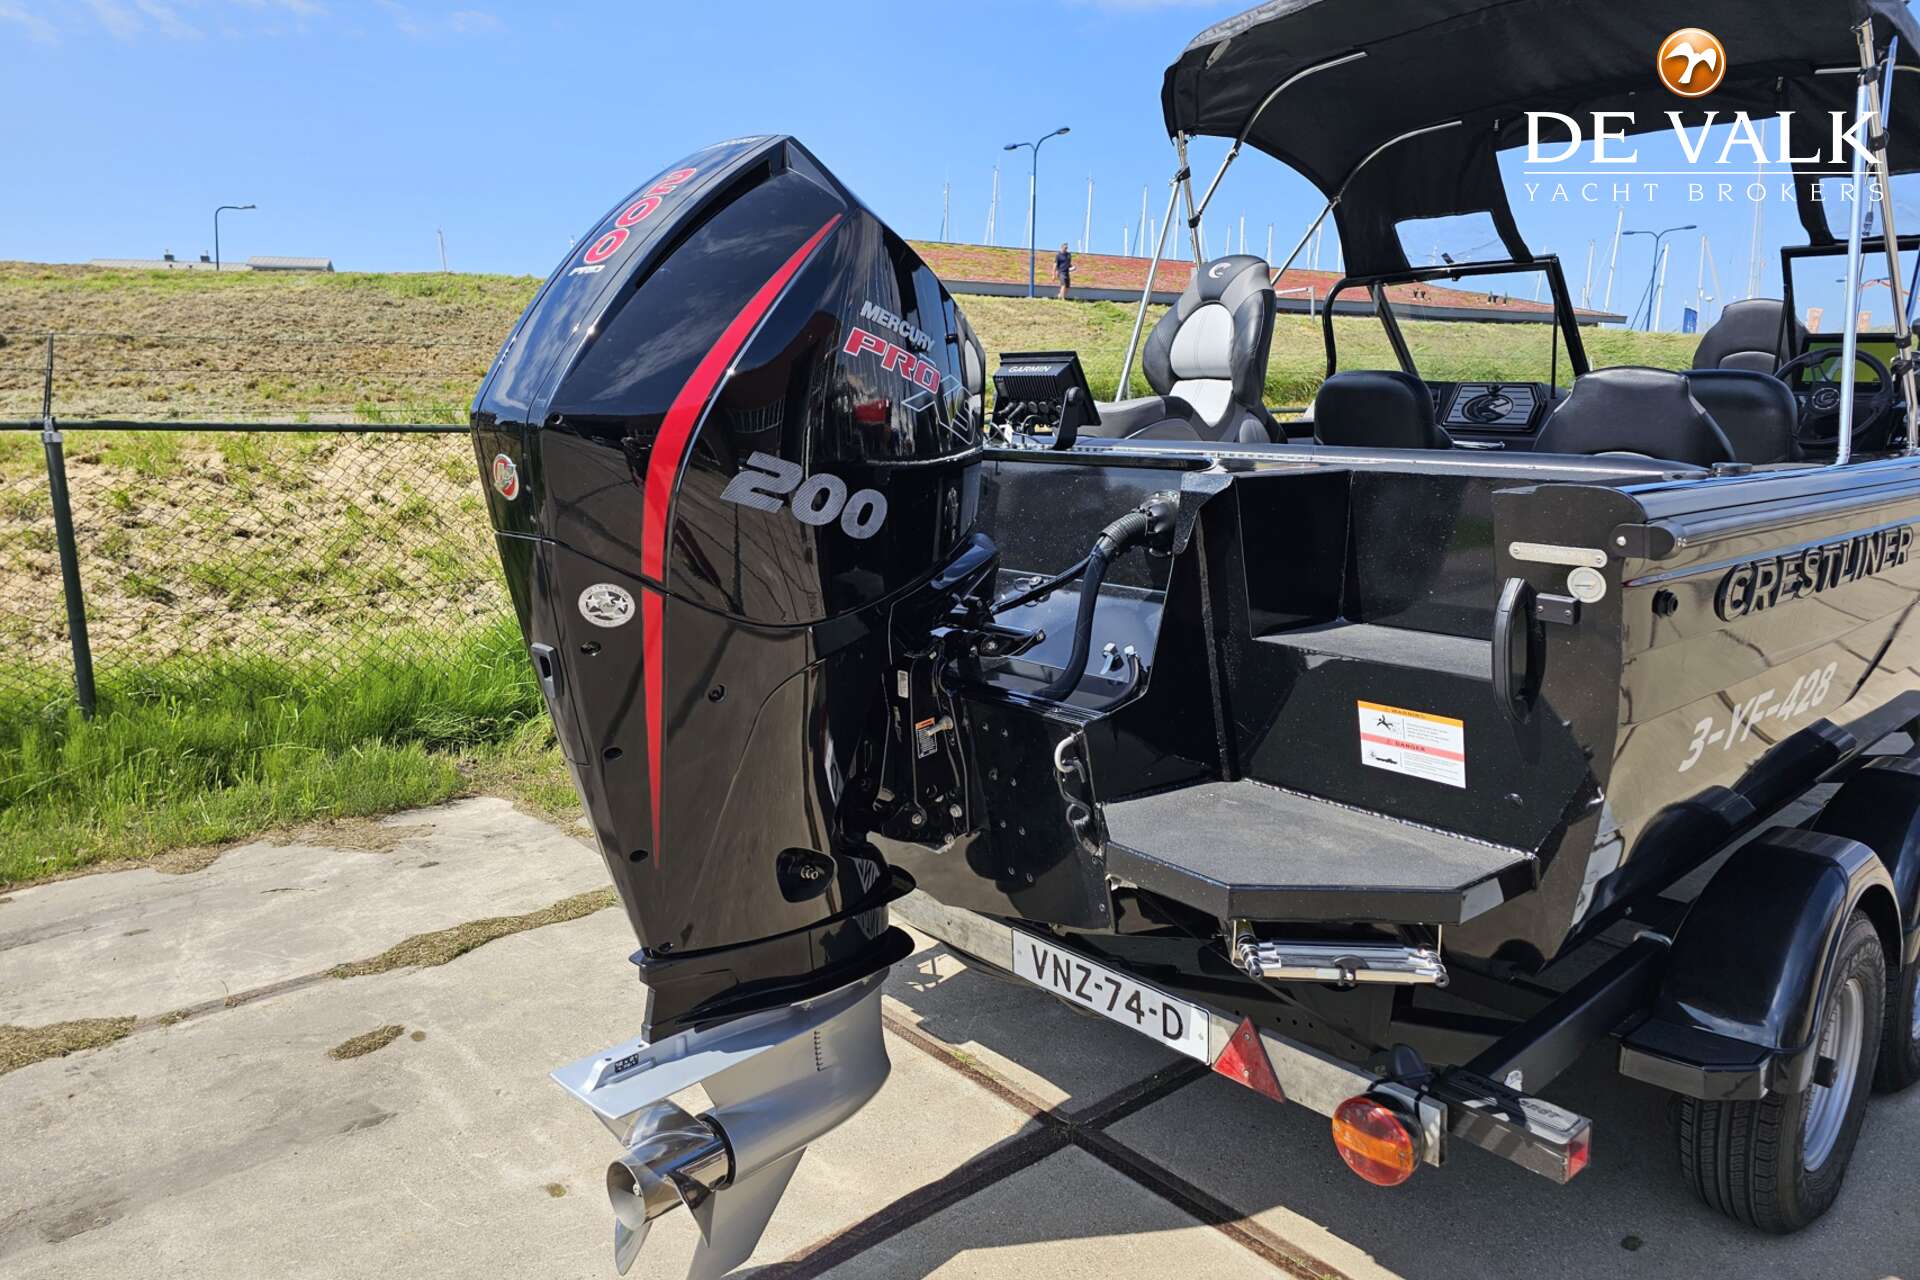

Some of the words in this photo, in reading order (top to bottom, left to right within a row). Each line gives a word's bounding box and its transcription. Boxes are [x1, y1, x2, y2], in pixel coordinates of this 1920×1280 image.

[583, 167, 697, 265] 200
[843, 327, 941, 395] PRO
[860, 300, 936, 351] MERCURY
[1008, 365, 1052, 373] GARMIN
[719, 450, 888, 540] 200
[1714, 523, 1914, 622] CRESTLINER
[1678, 661, 1838, 772] 3-YF-428
[1031, 944, 1183, 1041] VNZ-74-D
